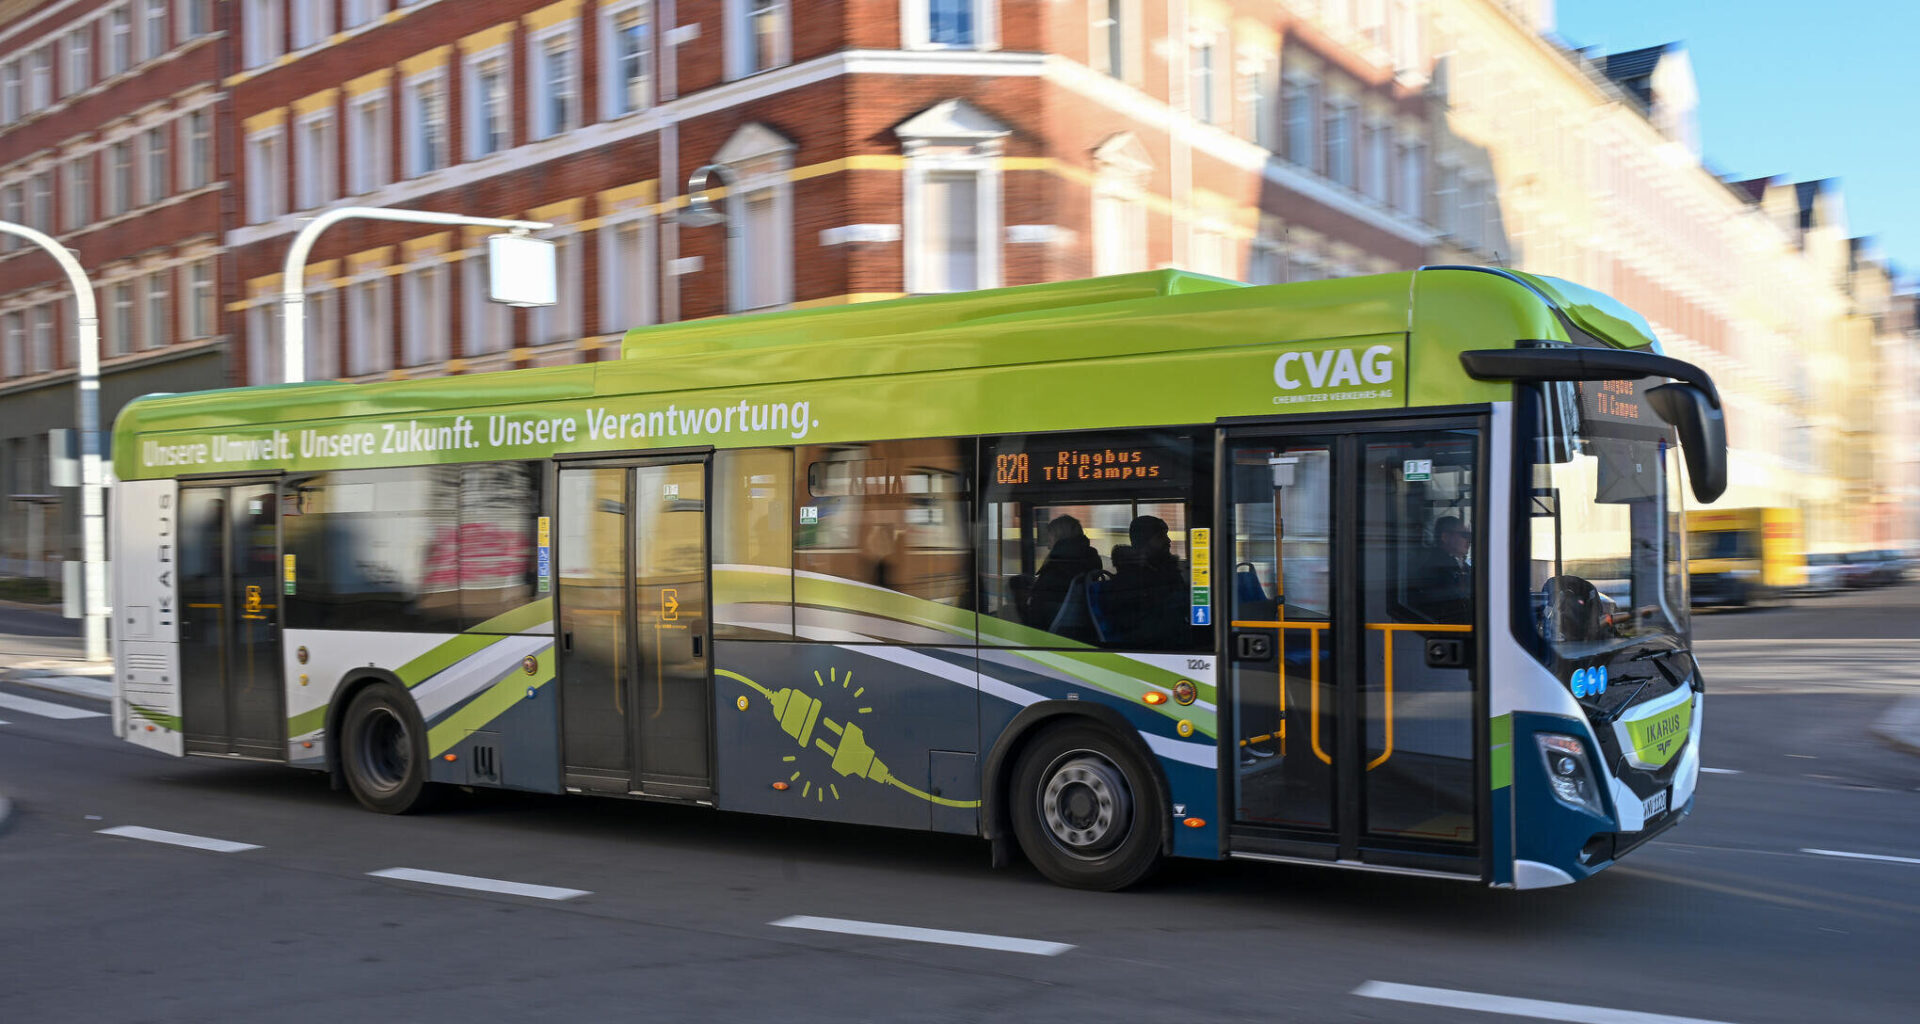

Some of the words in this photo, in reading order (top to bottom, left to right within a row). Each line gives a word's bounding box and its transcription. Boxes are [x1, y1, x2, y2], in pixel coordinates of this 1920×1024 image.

[1274, 345, 1393, 390] CVAG
[1273, 394, 1328, 404] CHEMNITZER
[1330, 389, 1393, 401] VERKEHRS-AG
[1610, 395, 1639, 418] Campus
[143, 440, 207, 466] Unsere
[212, 429, 294, 463] Umwelt.
[301, 429, 374, 458] Unsere
[380, 416, 480, 454] Zukunft.
[488, 416, 576, 447] Unsere
[586, 399, 819, 439] Verantwortung.
[996, 453, 1029, 484] 82A
[1058, 449, 1142, 466] Ringbus
[1043, 466, 1069, 481] TU
[1078, 465, 1160, 480] Campus
[159, 494, 171, 625] IKARUS
[1187, 659, 1211, 670] 120e
[1646, 714, 1680, 744] IKARUS
